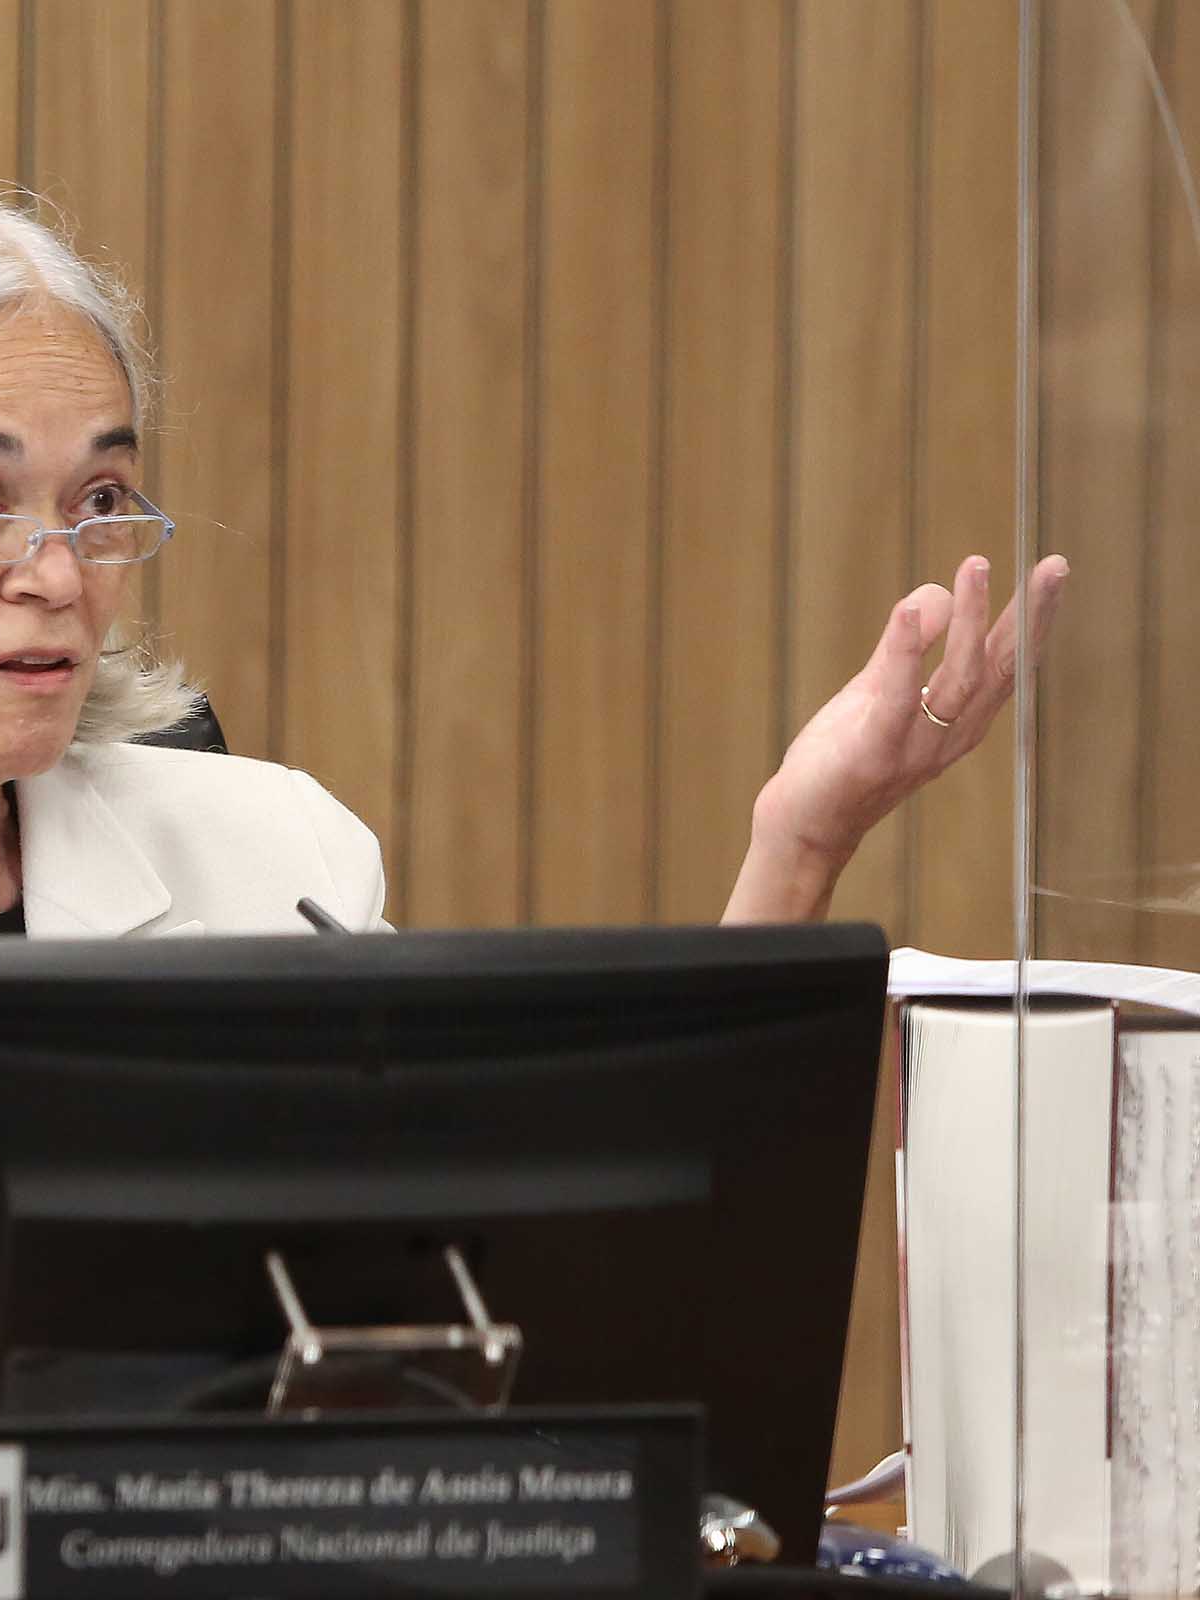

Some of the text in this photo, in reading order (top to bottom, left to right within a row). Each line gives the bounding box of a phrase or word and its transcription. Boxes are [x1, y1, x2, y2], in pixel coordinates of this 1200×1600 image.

[113, 1472, 221, 1510] Maria
[227, 1469, 364, 1507] Thereza
[369, 1466, 414, 1505] de
[420, 1464, 512, 1504] Assis
[520, 1464, 634, 1502] Moura
[60, 1518, 597, 1575] Corregedora Nacional de Justiça
